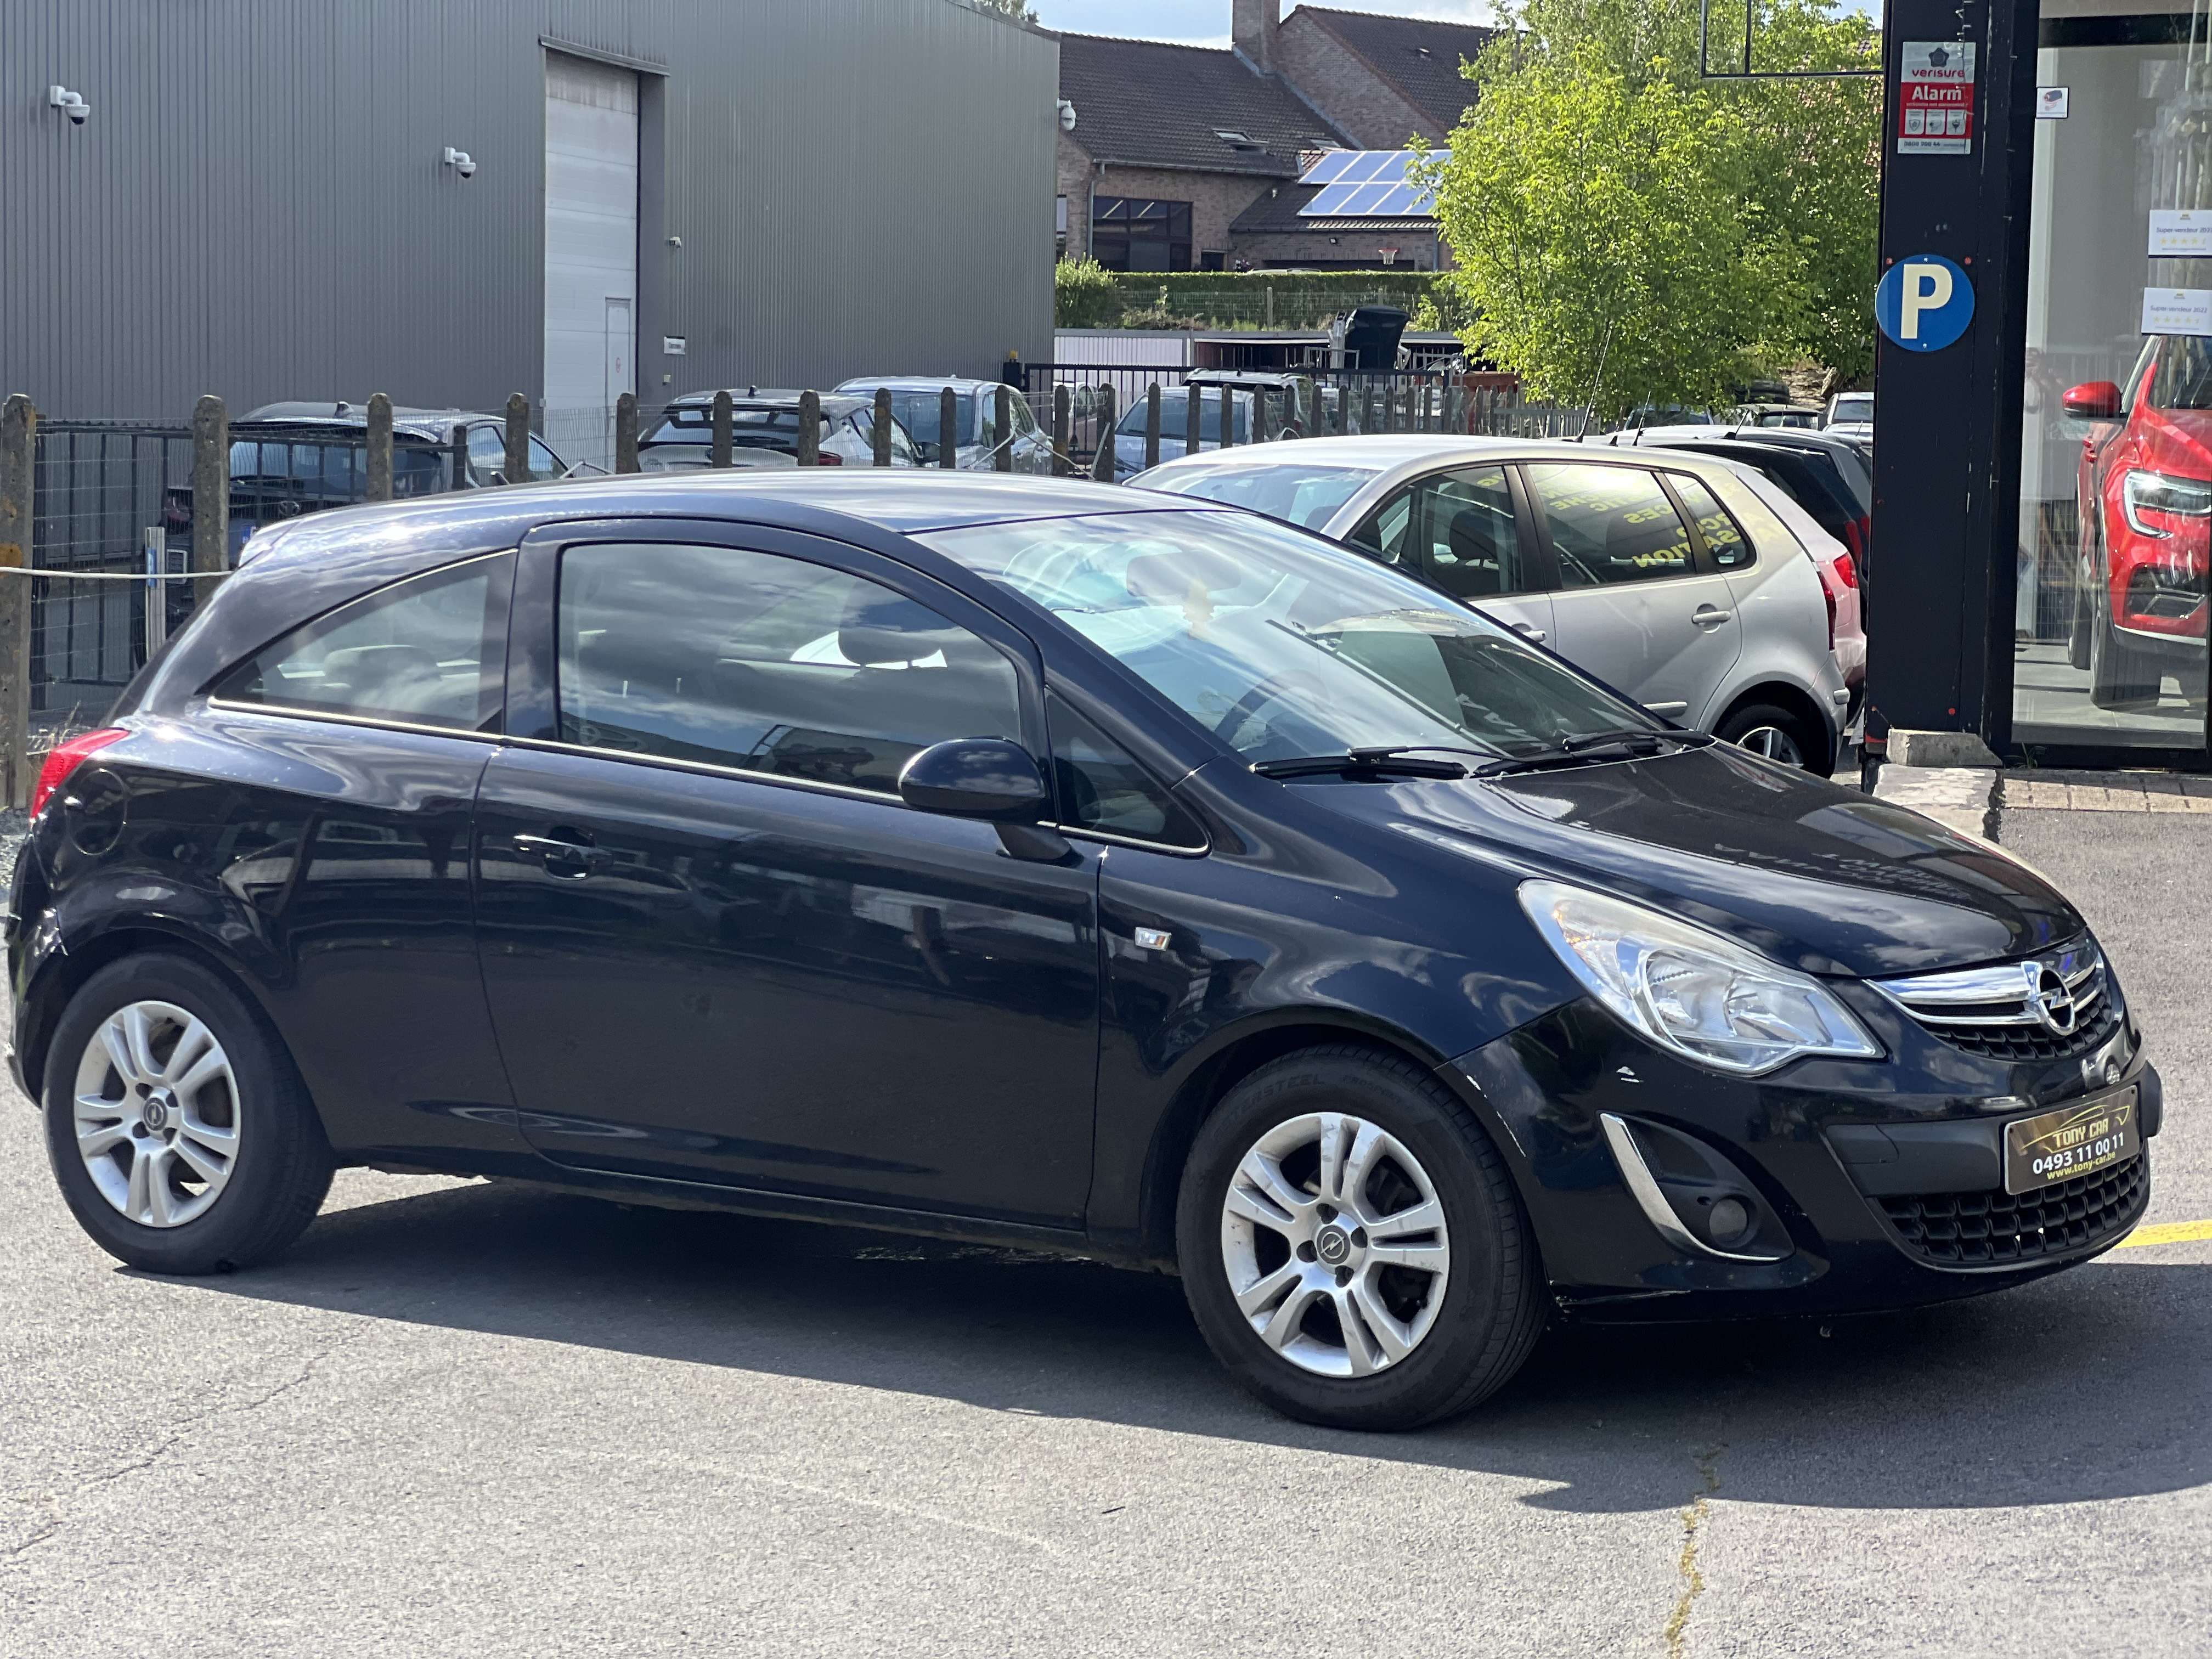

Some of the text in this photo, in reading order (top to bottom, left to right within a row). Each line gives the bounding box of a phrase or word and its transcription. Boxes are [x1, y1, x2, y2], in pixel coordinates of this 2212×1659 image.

[1911, 69, 1964, 77] verisure
[1911, 86, 1962, 100] Alarm
[1900, 264, 1953, 339] P
[2052, 1118, 2109, 1148] TONY CAR
[2032, 1131, 2124, 1175] 0493 11 00 11
[2046, 1151, 2117, 1180] www.tony-car.be
